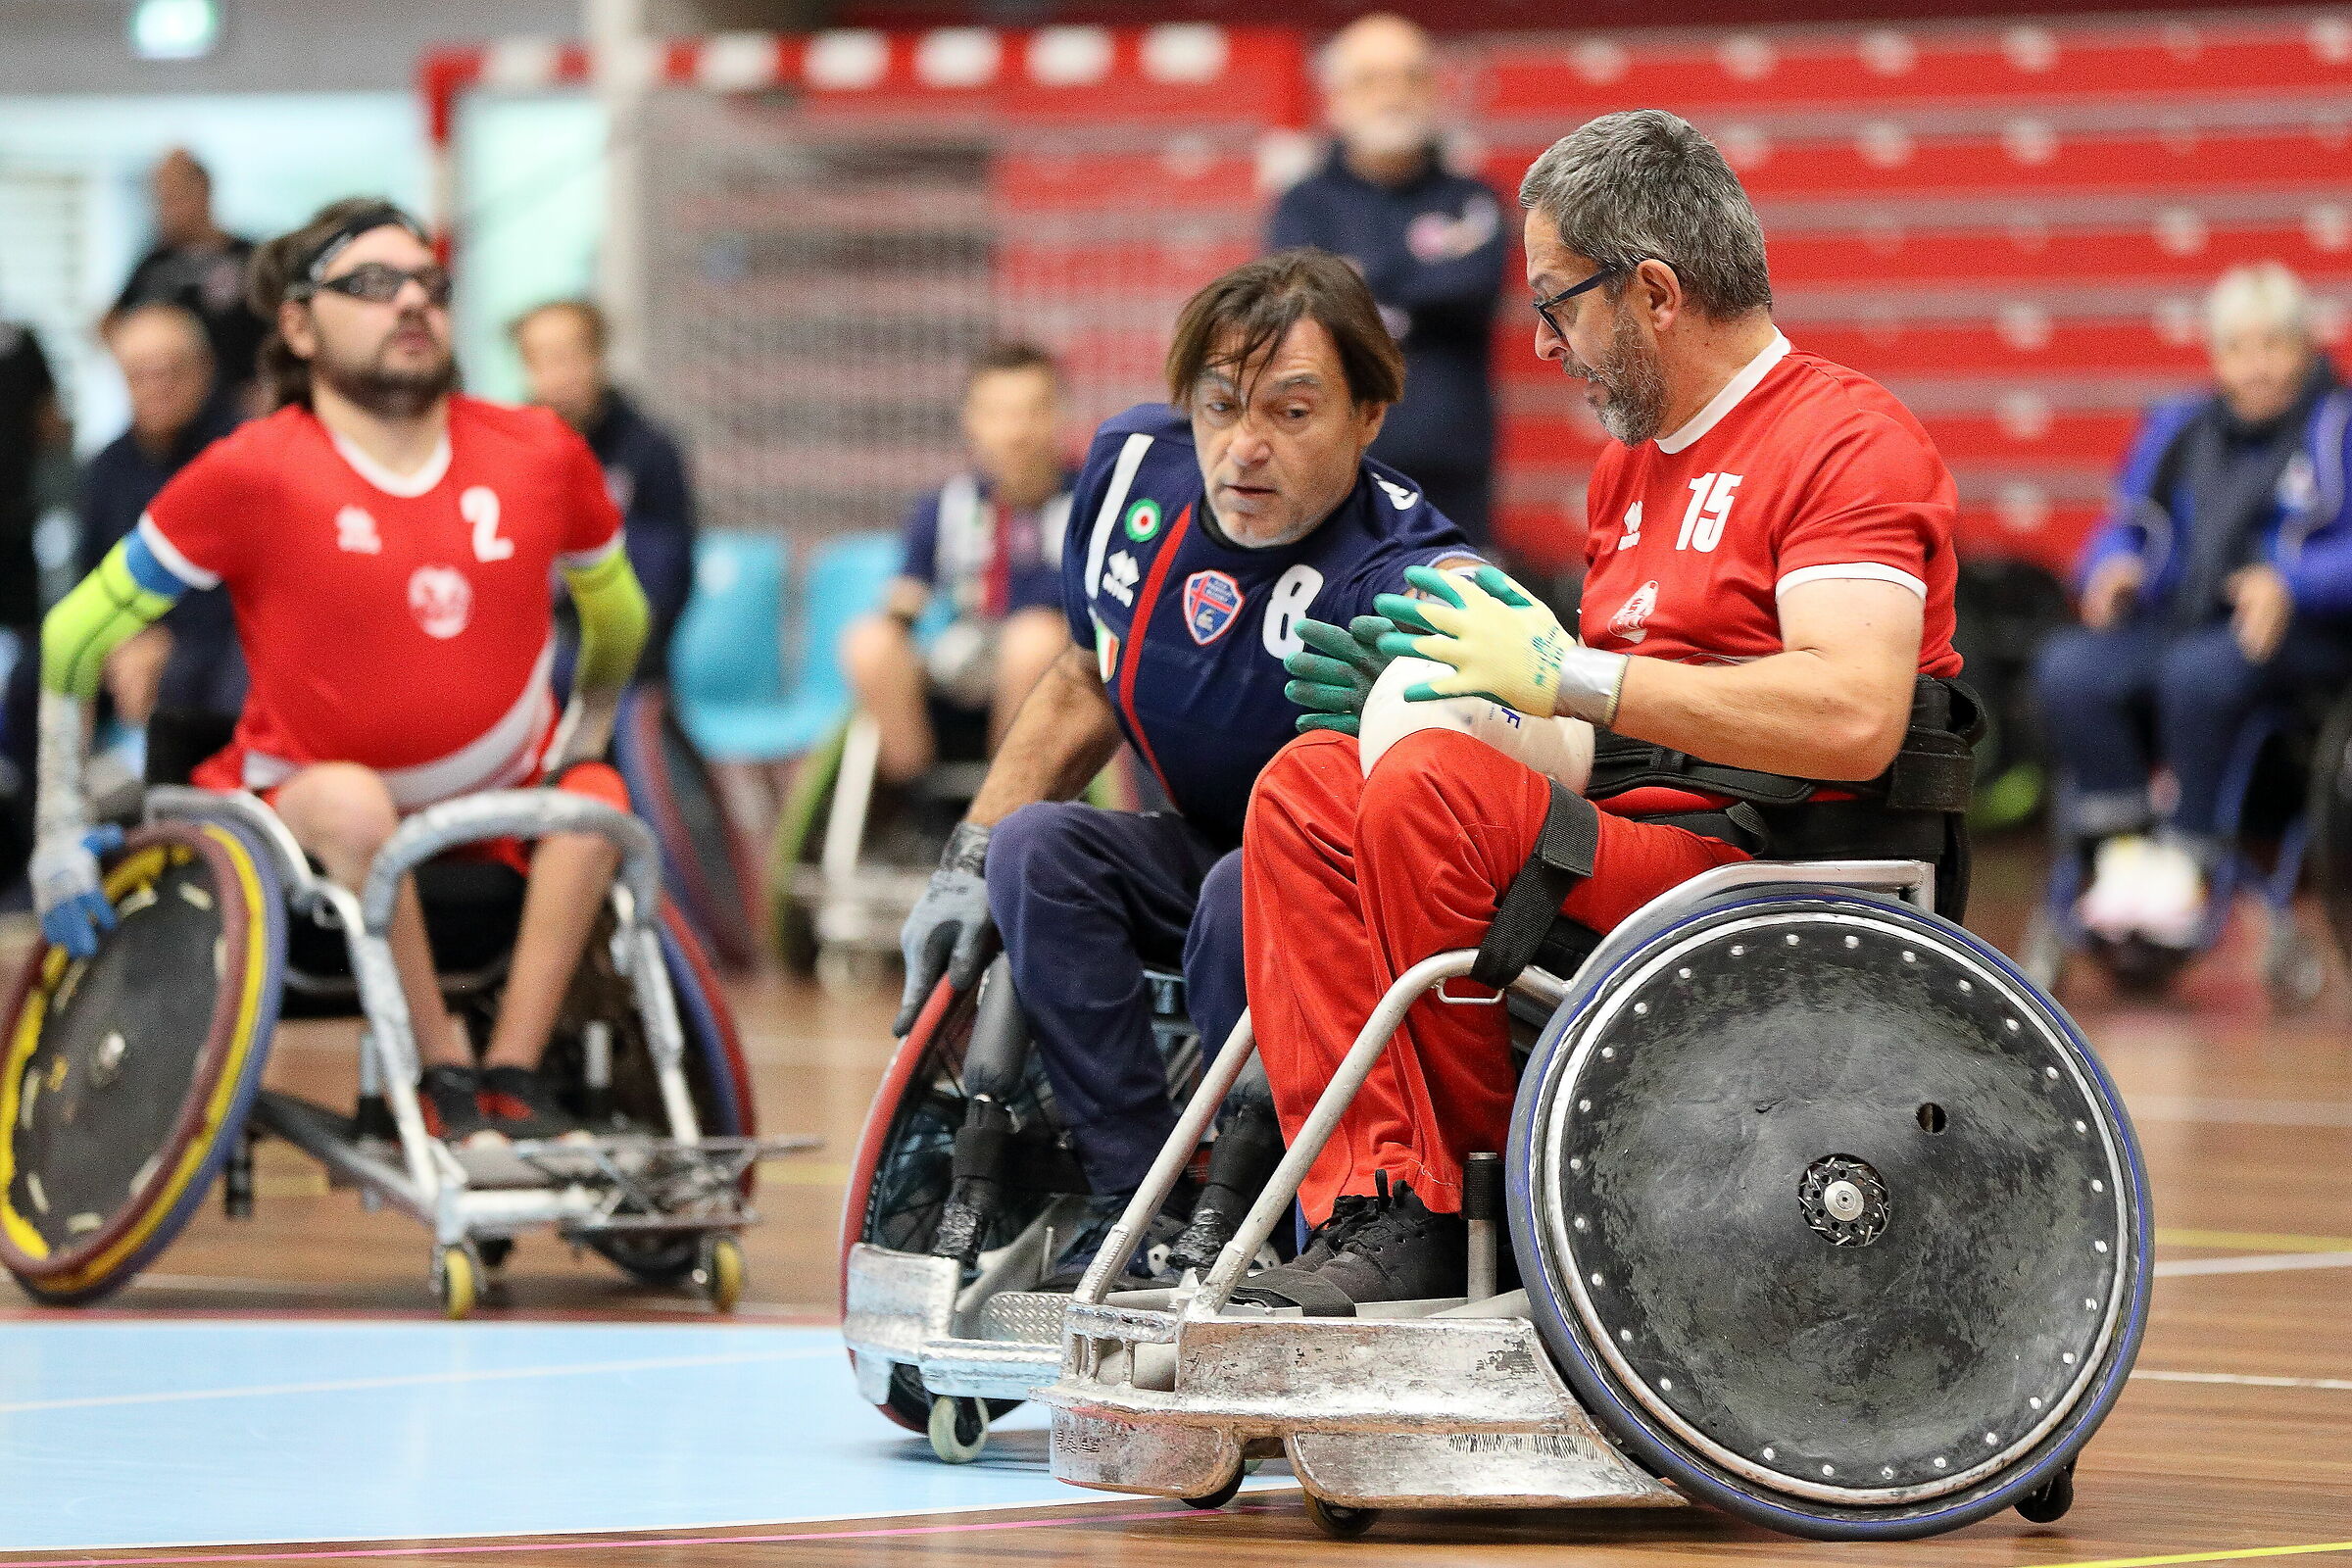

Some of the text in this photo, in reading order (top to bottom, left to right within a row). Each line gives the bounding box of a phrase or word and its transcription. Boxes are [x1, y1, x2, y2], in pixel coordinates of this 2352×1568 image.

[461, 486, 514, 563] 2
[1675, 471, 1743, 553] 15
[1262, 564, 1324, 660] 8
